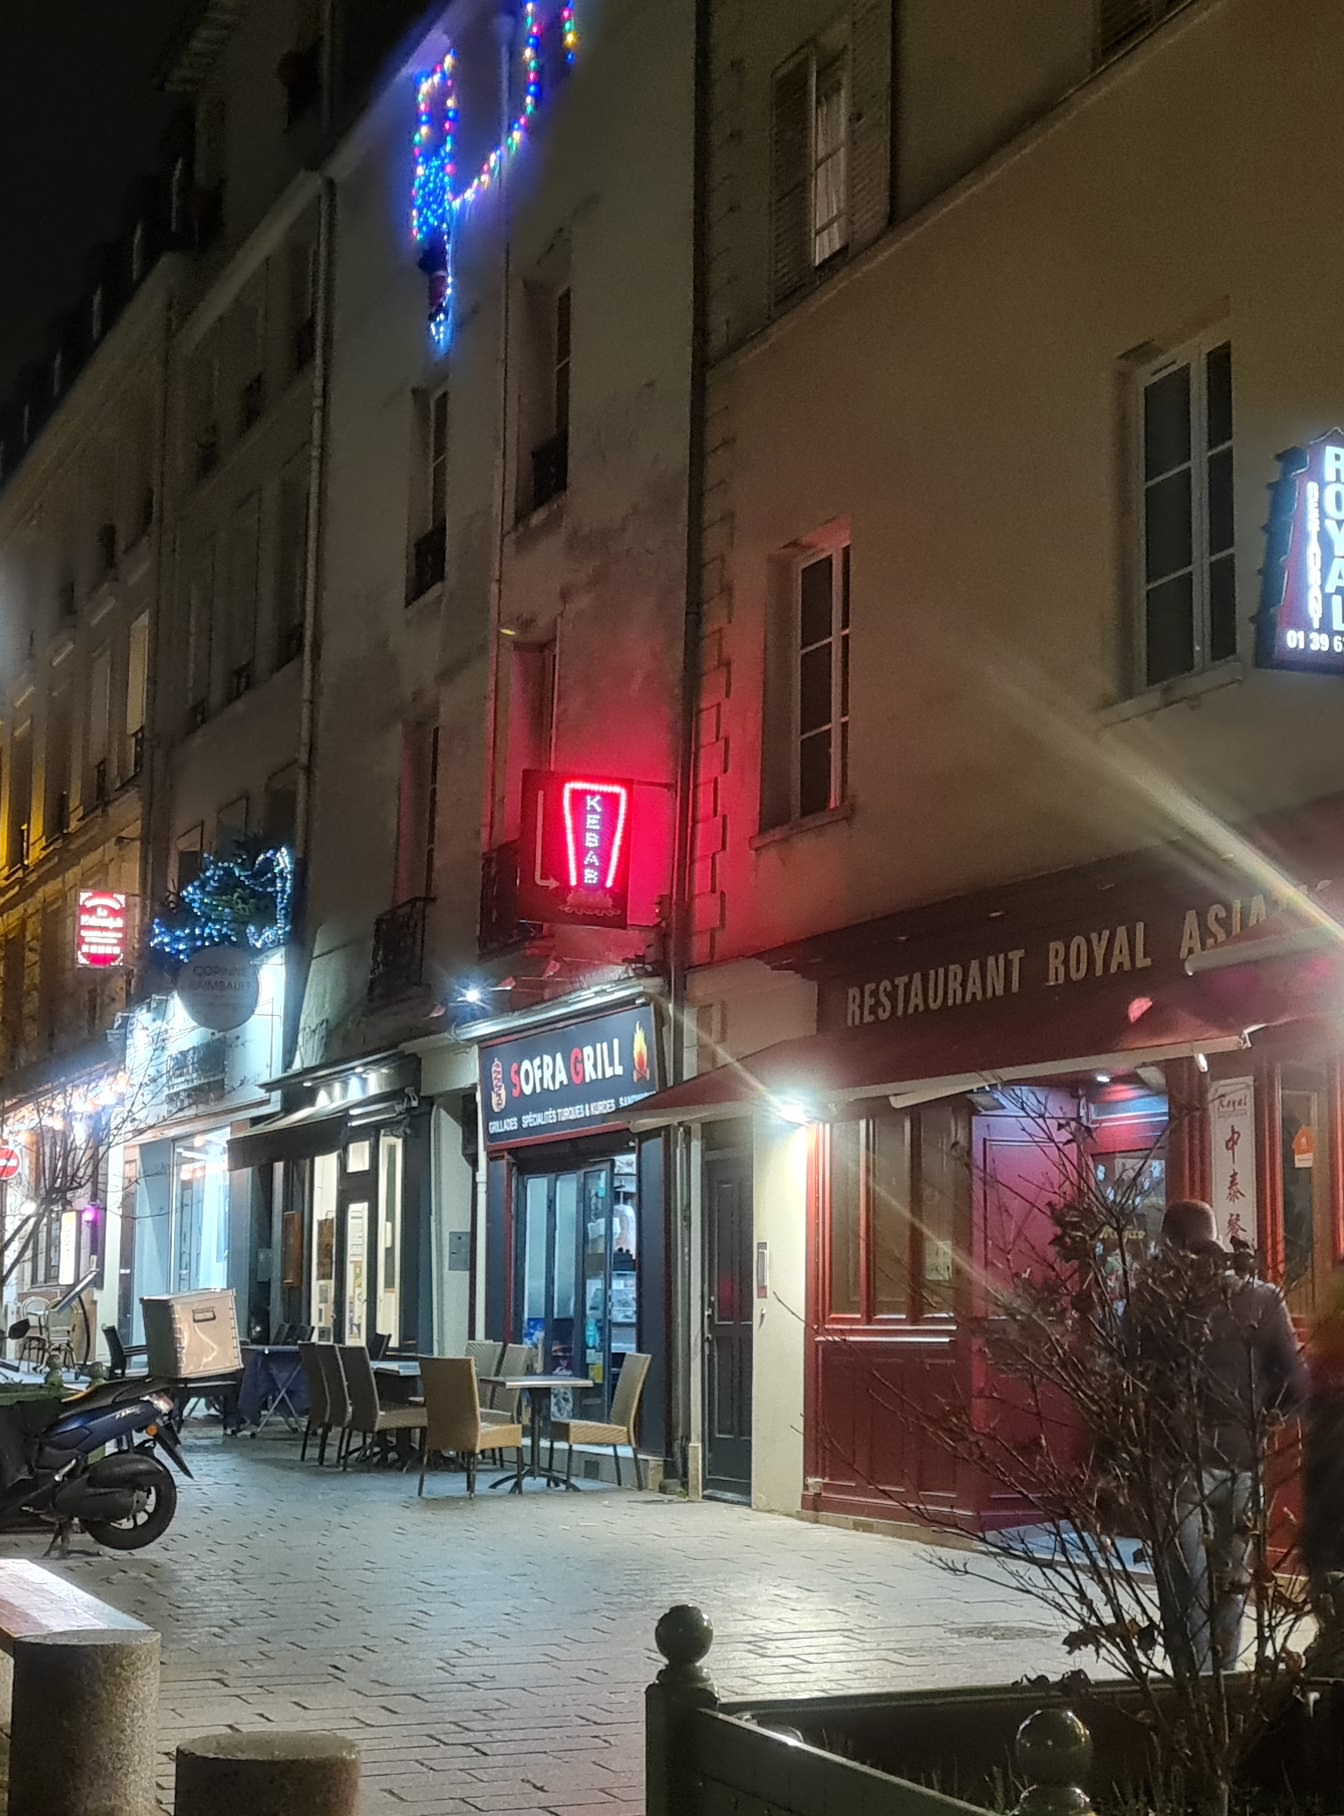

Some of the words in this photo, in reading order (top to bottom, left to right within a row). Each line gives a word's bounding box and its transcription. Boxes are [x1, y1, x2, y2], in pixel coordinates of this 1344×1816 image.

[1286, 630, 1305, 649] 01
[1309, 632, 1330, 652] 39
[583, 794, 603, 885] KEBAB
[846, 949, 1026, 1028] RESTAURANT
[1046, 921, 1153, 986] ROYAL
[510, 1052, 569, 1099] SOFRA
[569, 1038, 624, 1085] GRILL
[488, 1116, 519, 1135] GRILLADES
[521, 1107, 557, 1129] SPÉCIALITÉS
[557, 1103, 585, 1121] TURQUES
[590, 1098, 616, 1115] KURDES
